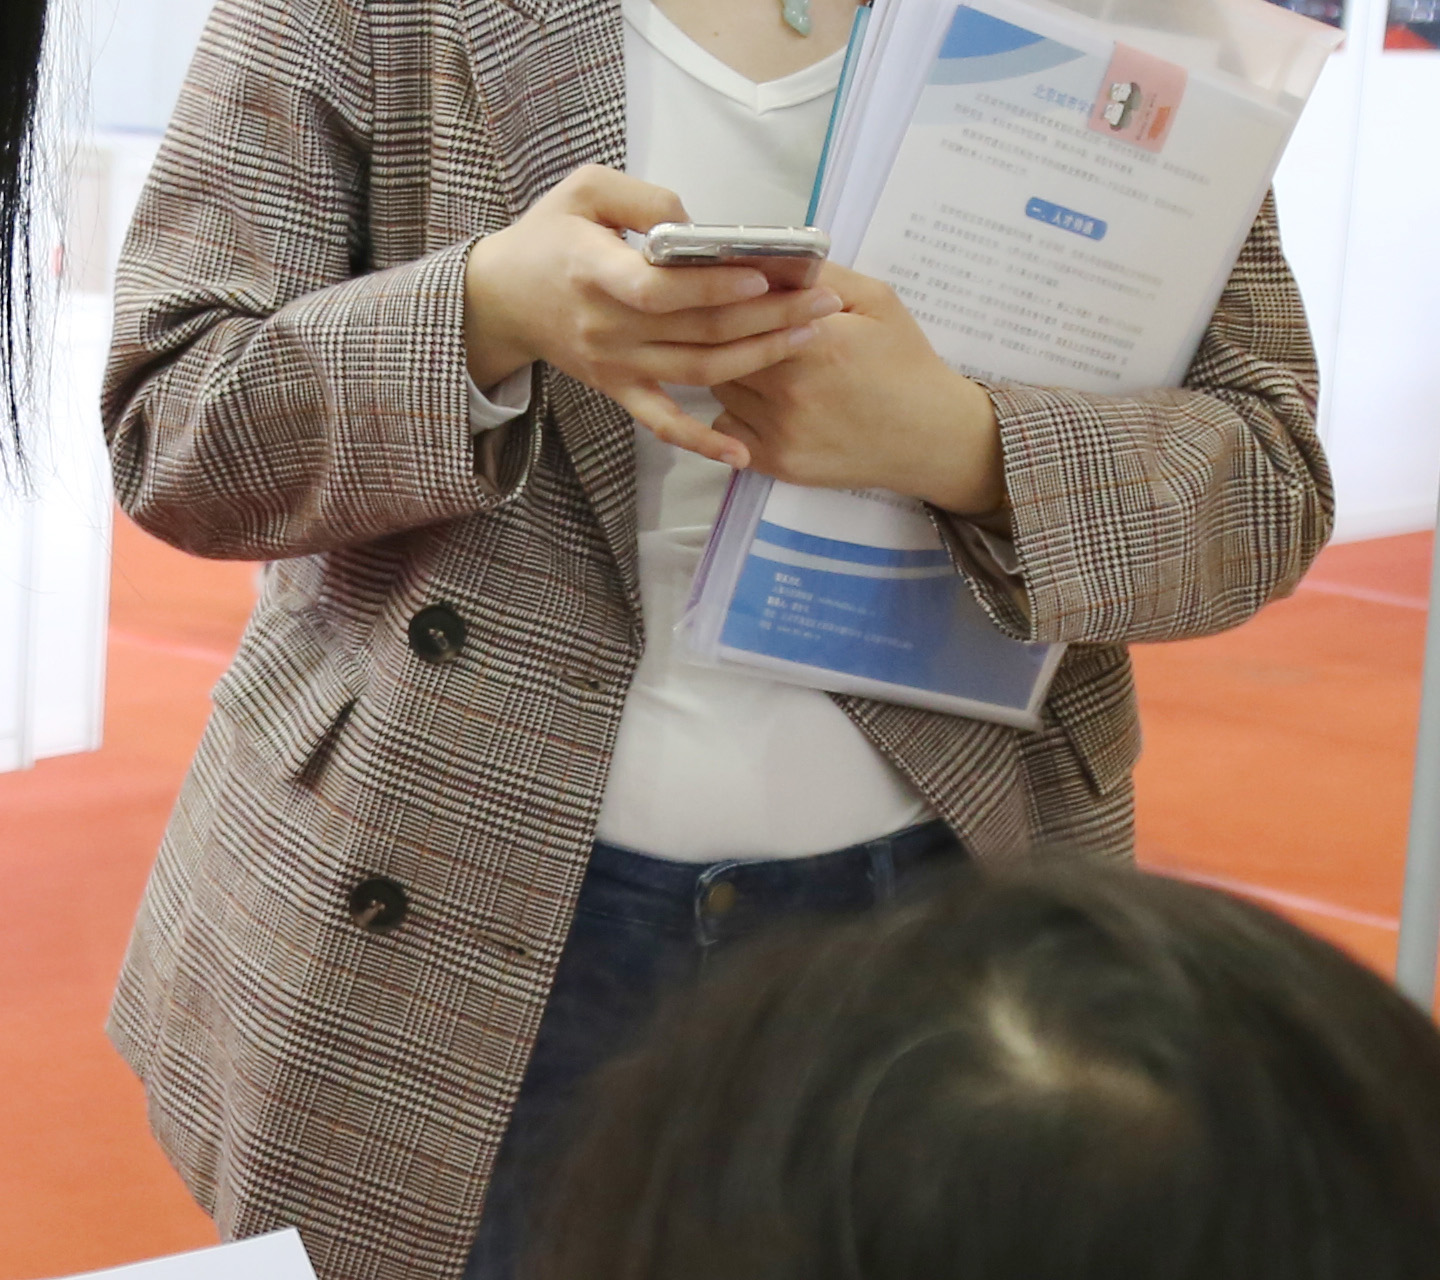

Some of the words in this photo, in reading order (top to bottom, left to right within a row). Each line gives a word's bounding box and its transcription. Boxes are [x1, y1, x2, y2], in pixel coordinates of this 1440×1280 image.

[1032, 84, 1096, 120] 北京城市学
